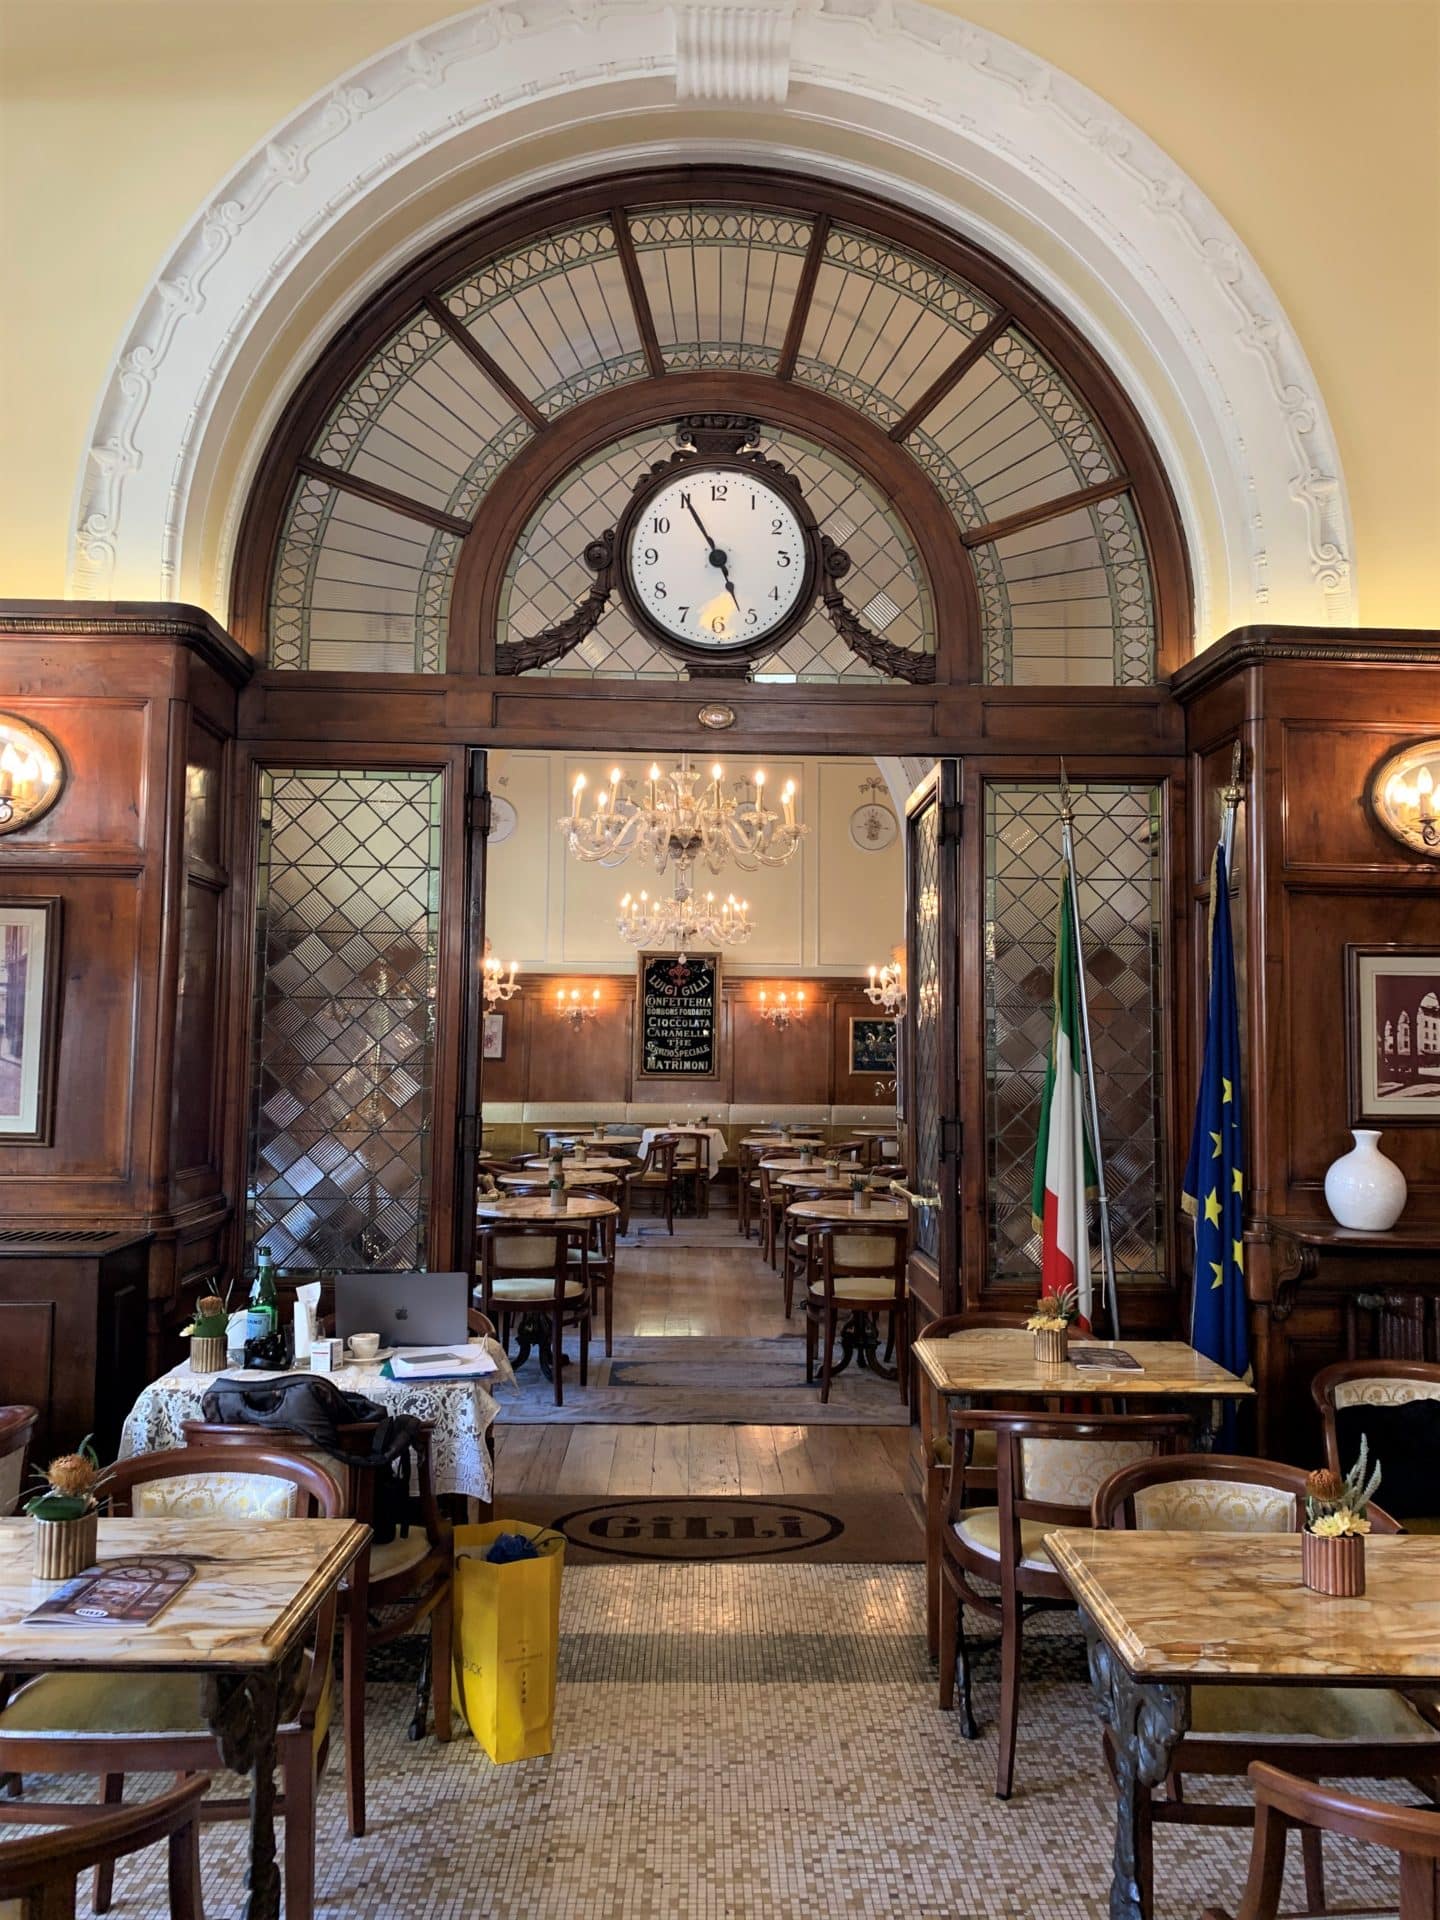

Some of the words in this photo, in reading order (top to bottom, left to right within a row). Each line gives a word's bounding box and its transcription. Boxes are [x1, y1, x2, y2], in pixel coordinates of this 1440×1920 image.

[711, 485, 728, 501] 12
[652, 517, 670, 534] 10
[771, 519, 783, 535] 2
[644, 548, 659, 566] 9
[777, 550, 791, 567] 3
[654, 582, 667, 599] 8
[768, 586, 780, 601] 4
[678, 606, 690, 623] 7
[744, 608, 758, 625] 5
[711, 617, 725, 634] 6
[649, 975, 677, 996] LUIGI
[681, 975, 710, 996] GILLI
[645, 994, 712, 1007] CONFETTERIA
[648, 1016, 711, 1028] CIOCCOLATA
[647, 1028, 709, 1037] CARAMELL
[647, 1056, 709, 1070] MATRIMONI
